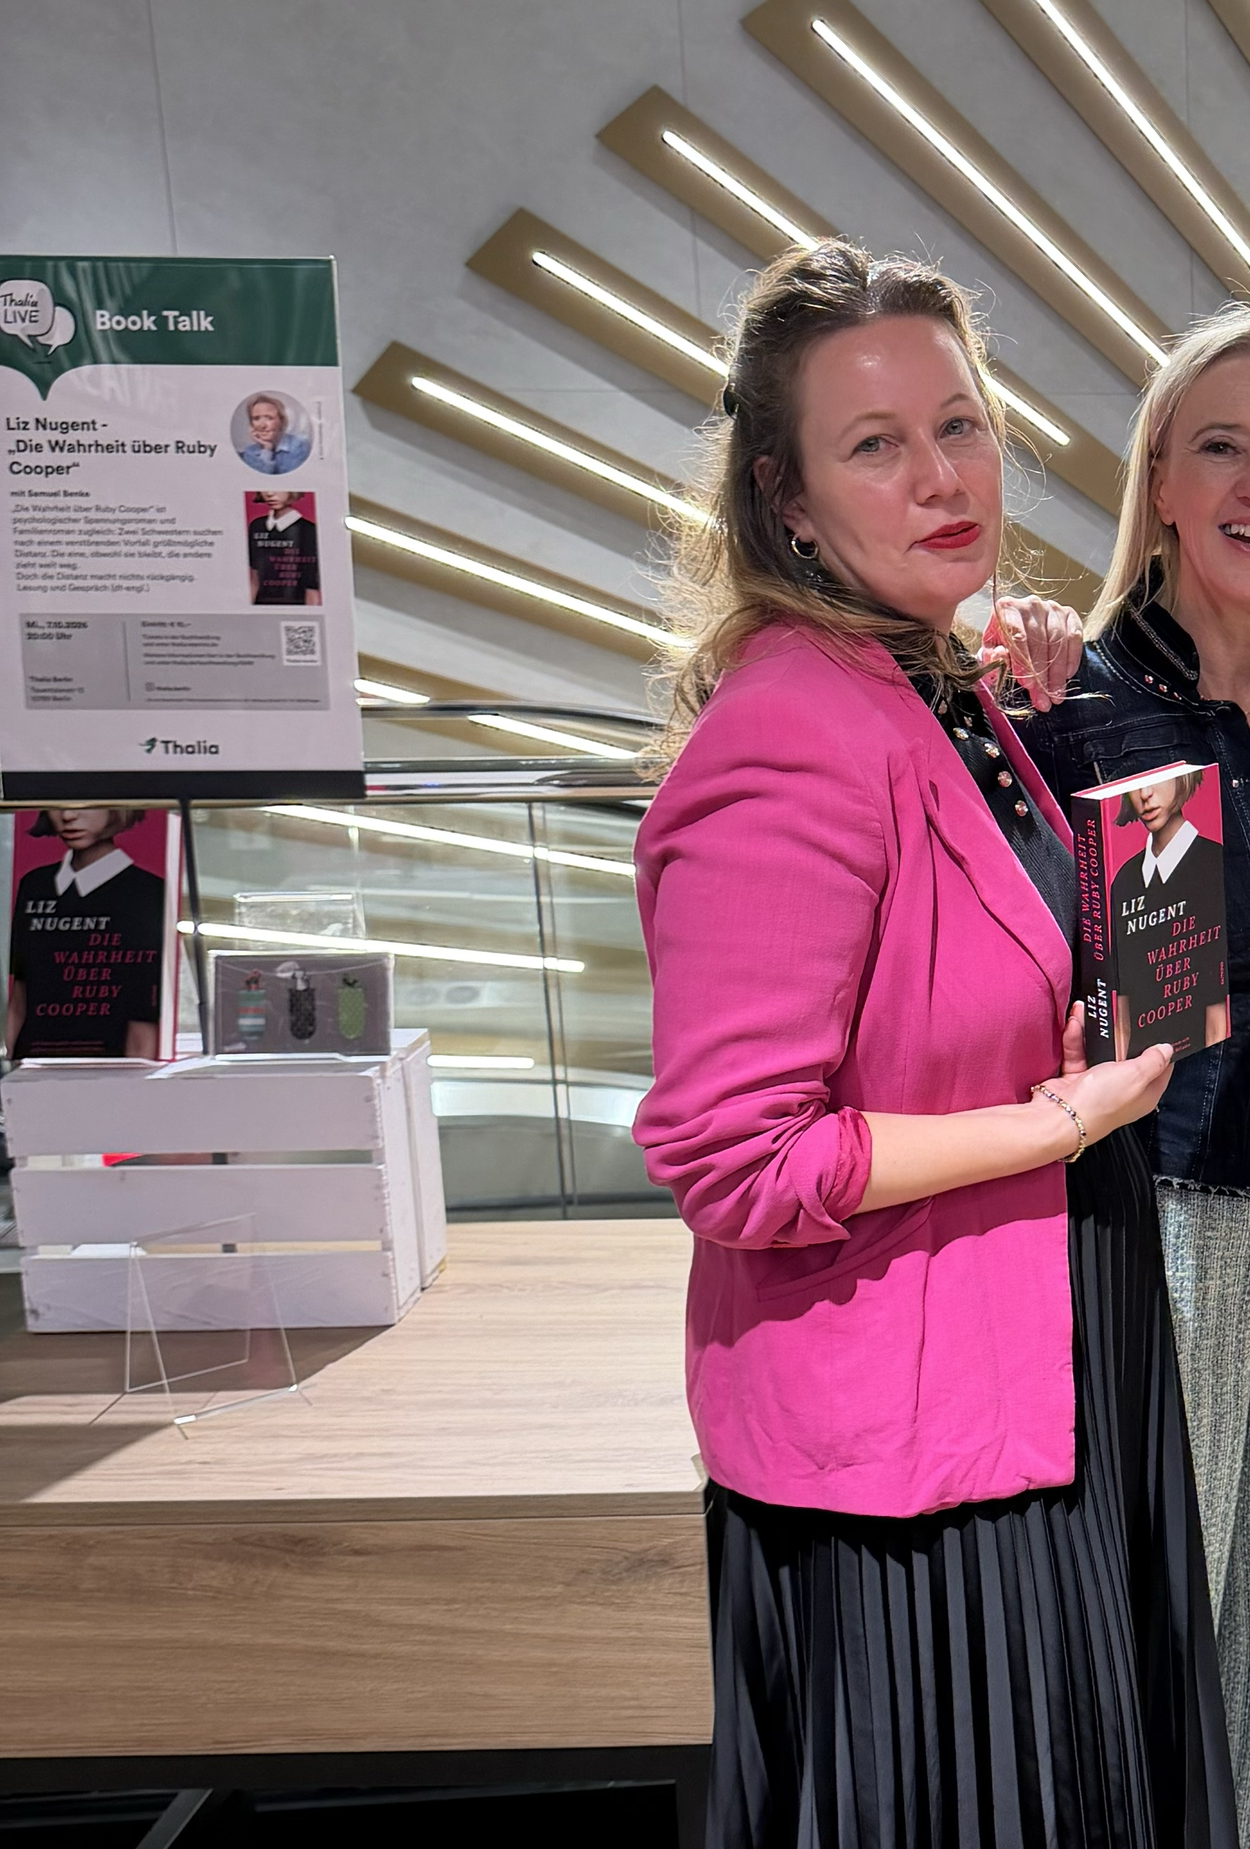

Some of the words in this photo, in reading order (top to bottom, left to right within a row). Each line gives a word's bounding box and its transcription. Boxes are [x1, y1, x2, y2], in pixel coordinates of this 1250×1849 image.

[0, 293, 38, 307] Thalia
[4, 309, 39, 323] LIVE
[95, 310, 157, 331] Book
[162, 311, 214, 332] Talk
[6, 418, 30, 431] Liz
[35, 418, 98, 434] Nugent
[47, 440, 127, 454] Wahrheit
[132, 440, 170, 454] über
[176, 441, 217, 457] Ruby
[160, 740, 220, 755] Thalia
[1087, 819, 1099, 877] COOPER
[1078, 834, 1090, 912] WAHRHEIT
[25, 901, 57, 914] LIZ
[1090, 882, 1101, 919] RUBY
[1121, 895, 1146, 917] LIZ
[30, 917, 110, 931] NUGENT
[1126, 901, 1187, 935] NUGENT
[1171, 916, 1196, 937] DIE
[88, 933, 122, 946] DIE
[1083, 918, 1092, 943] DIE
[1093, 924, 1104, 961] ÜBER
[1146, 925, 1221, 965] WAHRHEIT
[53, 951, 157, 964] WAHRHEIT
[62, 966, 112, 981] ÜBER
[1154, 957, 1191, 982] ÜBER
[72, 985, 122, 998] RUBY
[1163, 972, 1199, 999] RUBY
[35, 1003, 111, 1016] COOPER
[1087, 995, 1097, 1019] LIZ
[1097, 978, 1109, 1039] NUGENT
[1137, 994, 1193, 1028] COOPER
